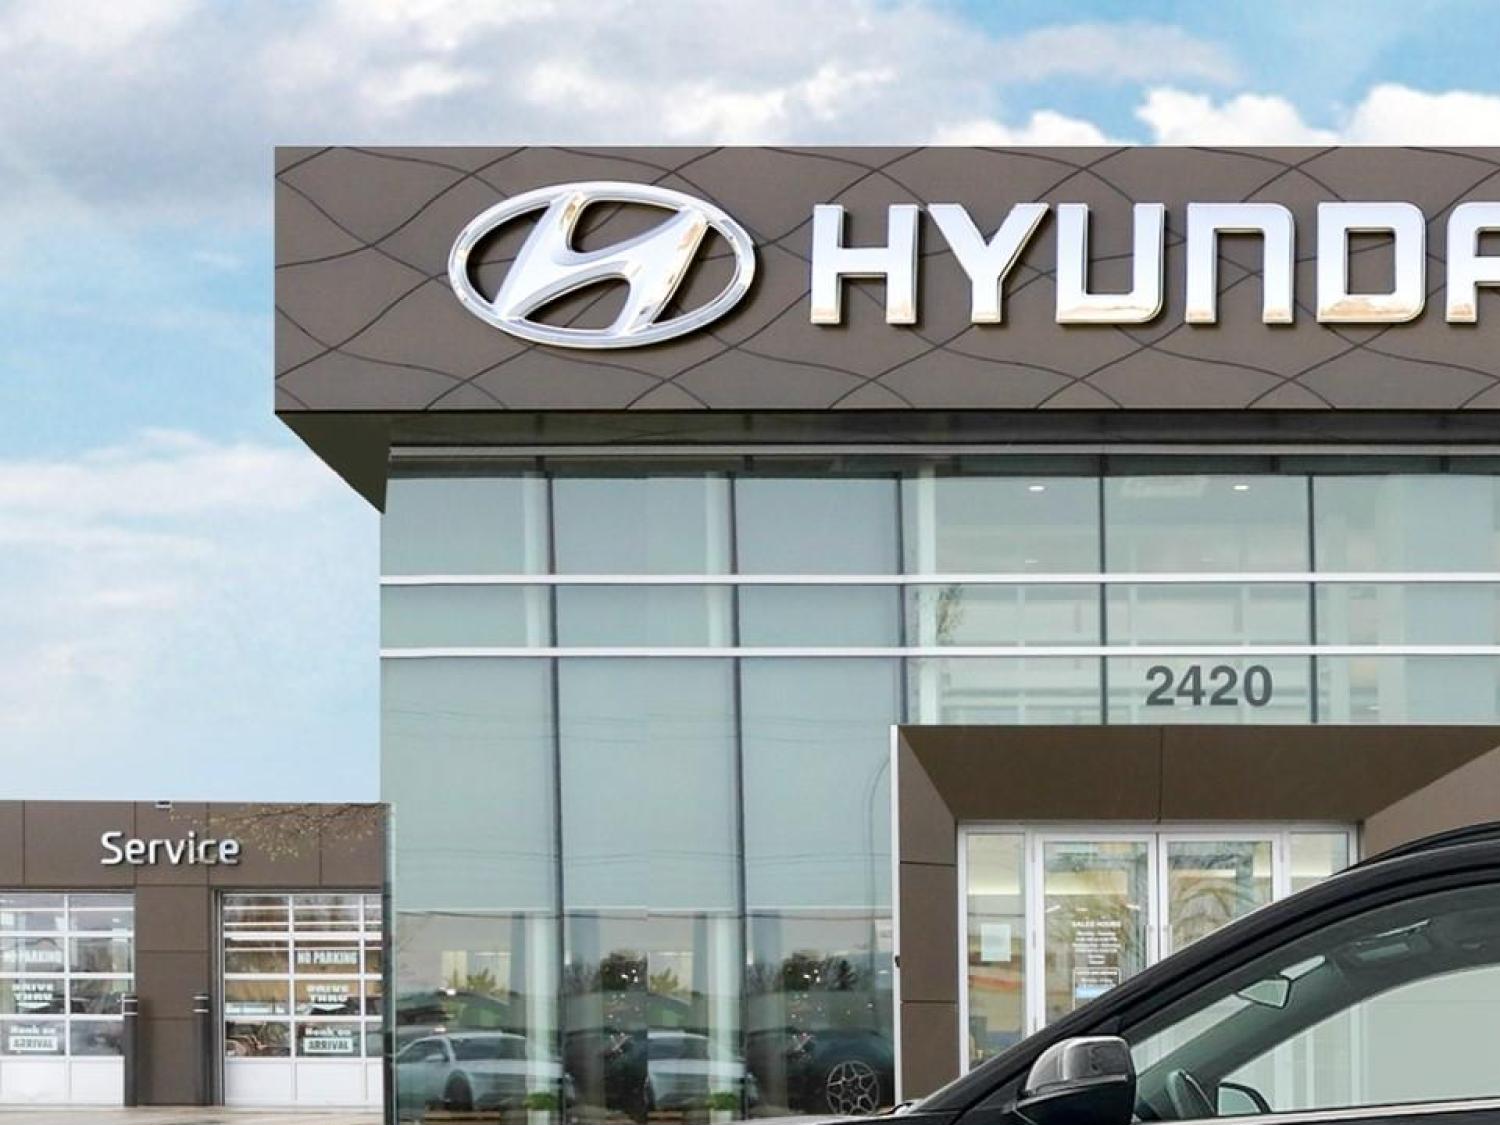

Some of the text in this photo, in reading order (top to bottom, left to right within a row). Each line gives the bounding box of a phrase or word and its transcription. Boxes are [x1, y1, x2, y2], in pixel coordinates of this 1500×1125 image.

[1146, 665, 1273, 706] 2420
[100, 830, 240, 865] Service
[308, 1039, 349, 1050] ARRIVAL
